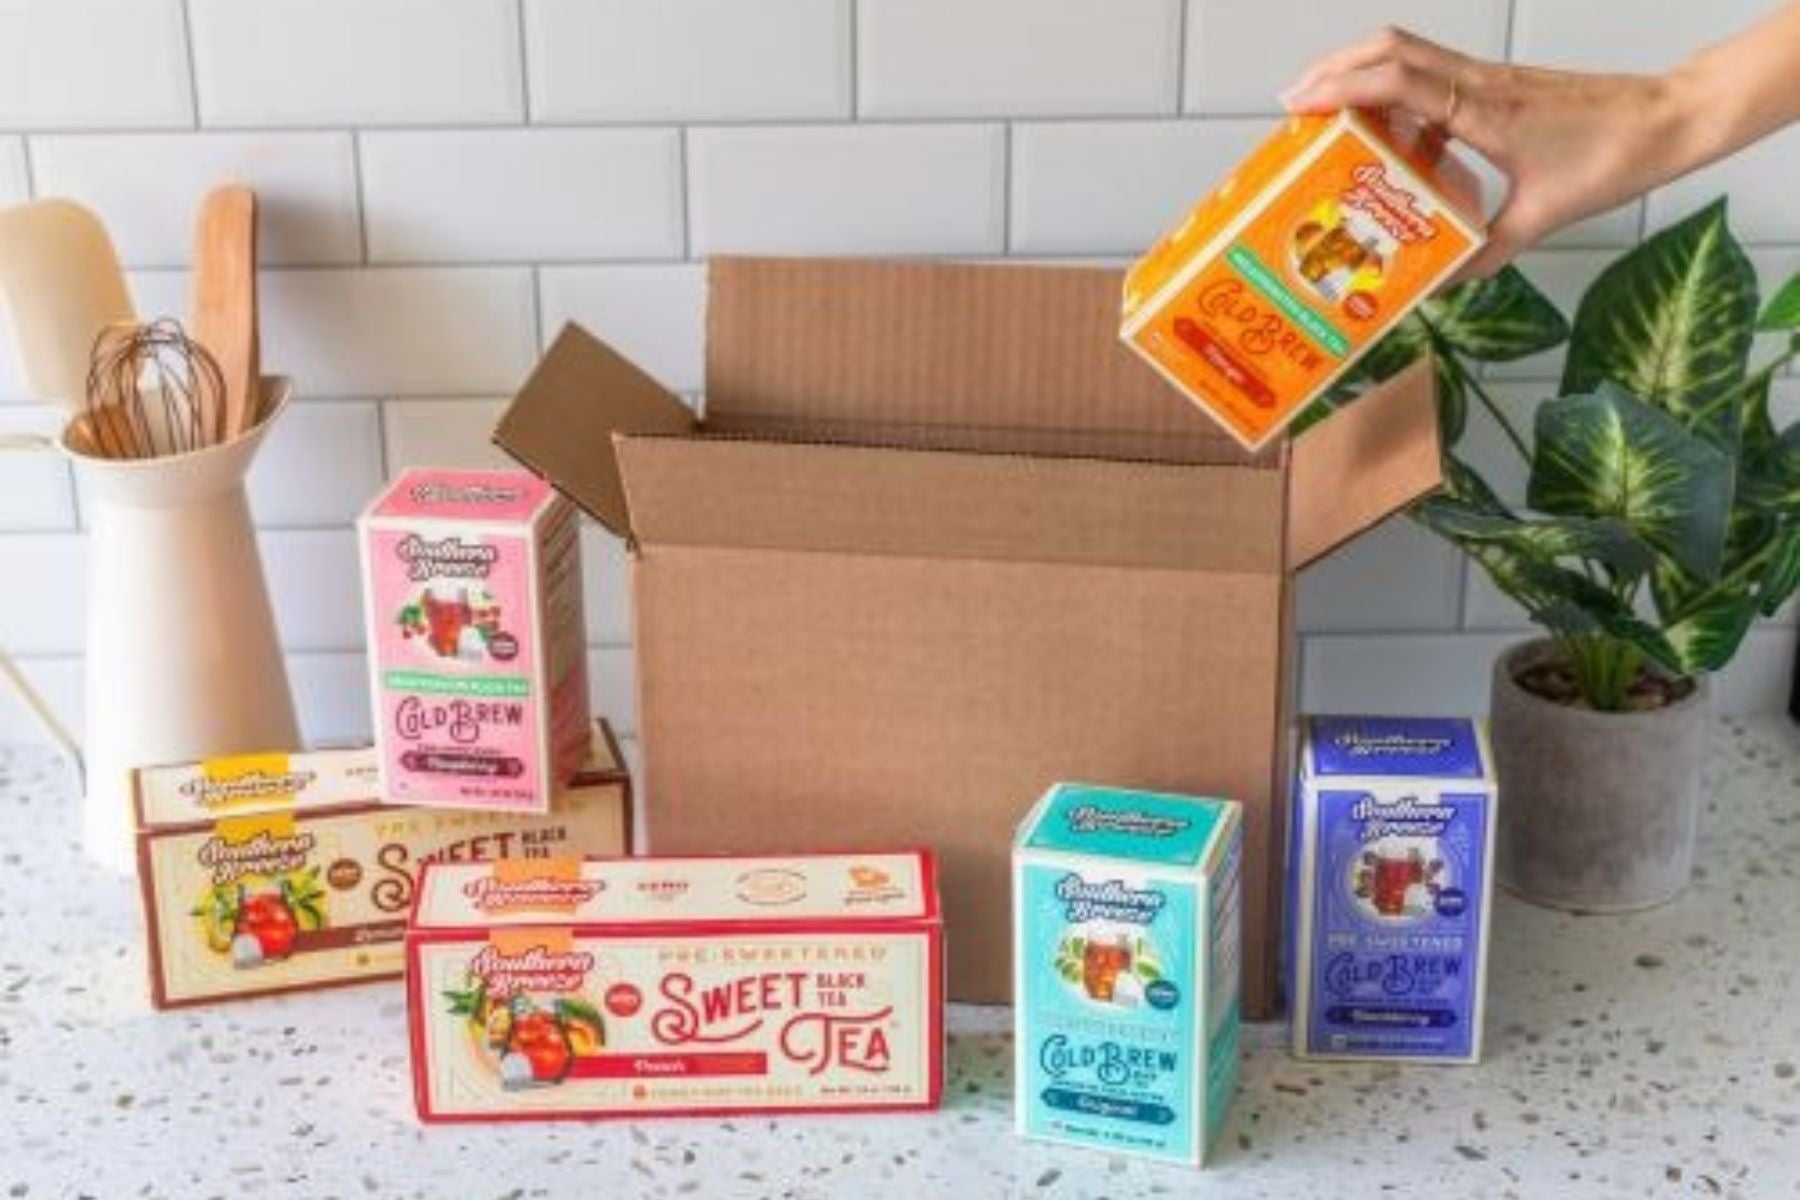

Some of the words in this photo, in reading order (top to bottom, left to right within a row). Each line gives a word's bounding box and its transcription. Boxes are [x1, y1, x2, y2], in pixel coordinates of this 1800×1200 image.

[396, 695, 447, 740] COLD
[449, 699, 523, 744] BREW
[1325, 953, 1382, 998] COLD
[1382, 955, 1462, 996] BREW
[651, 971, 808, 1045] SWEET
[780, 1005, 894, 1075] TEA
[1039, 1034, 1096, 1078] COLD
[1097, 1041, 1178, 1085] BREW
